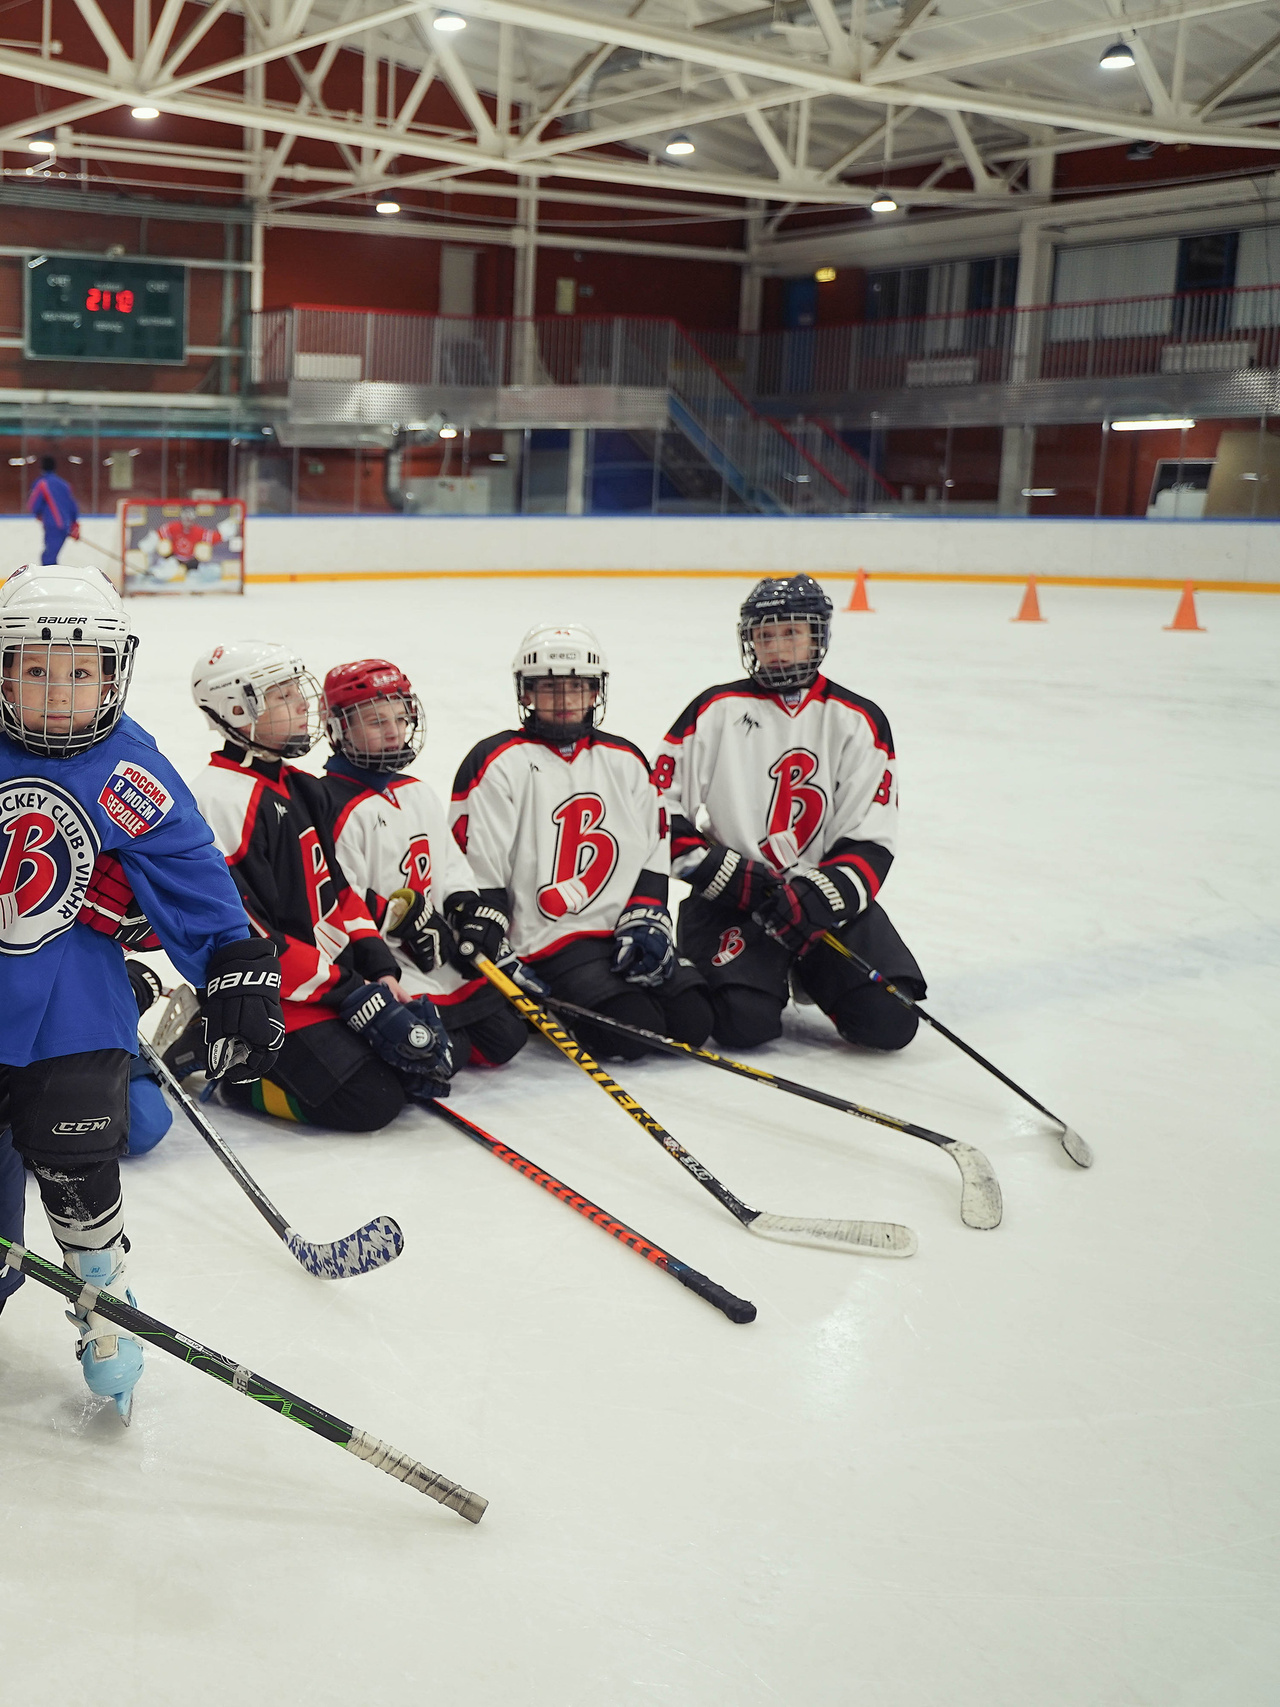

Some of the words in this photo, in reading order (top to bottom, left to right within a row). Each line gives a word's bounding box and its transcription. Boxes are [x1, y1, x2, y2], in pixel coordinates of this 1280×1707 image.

[37, 616, 88, 625] BAUER
[114, 779, 122, 792] В
[120, 788, 156, 821] МОЁМ
[122, 767, 167, 807] РОССИЯ
[51, 804, 85, 850] CLUB
[106, 794, 145, 834] СЕРДЦЕ
[57, 863, 91, 920] VIKHR
[58, 1119, 110, 1133] CCM
